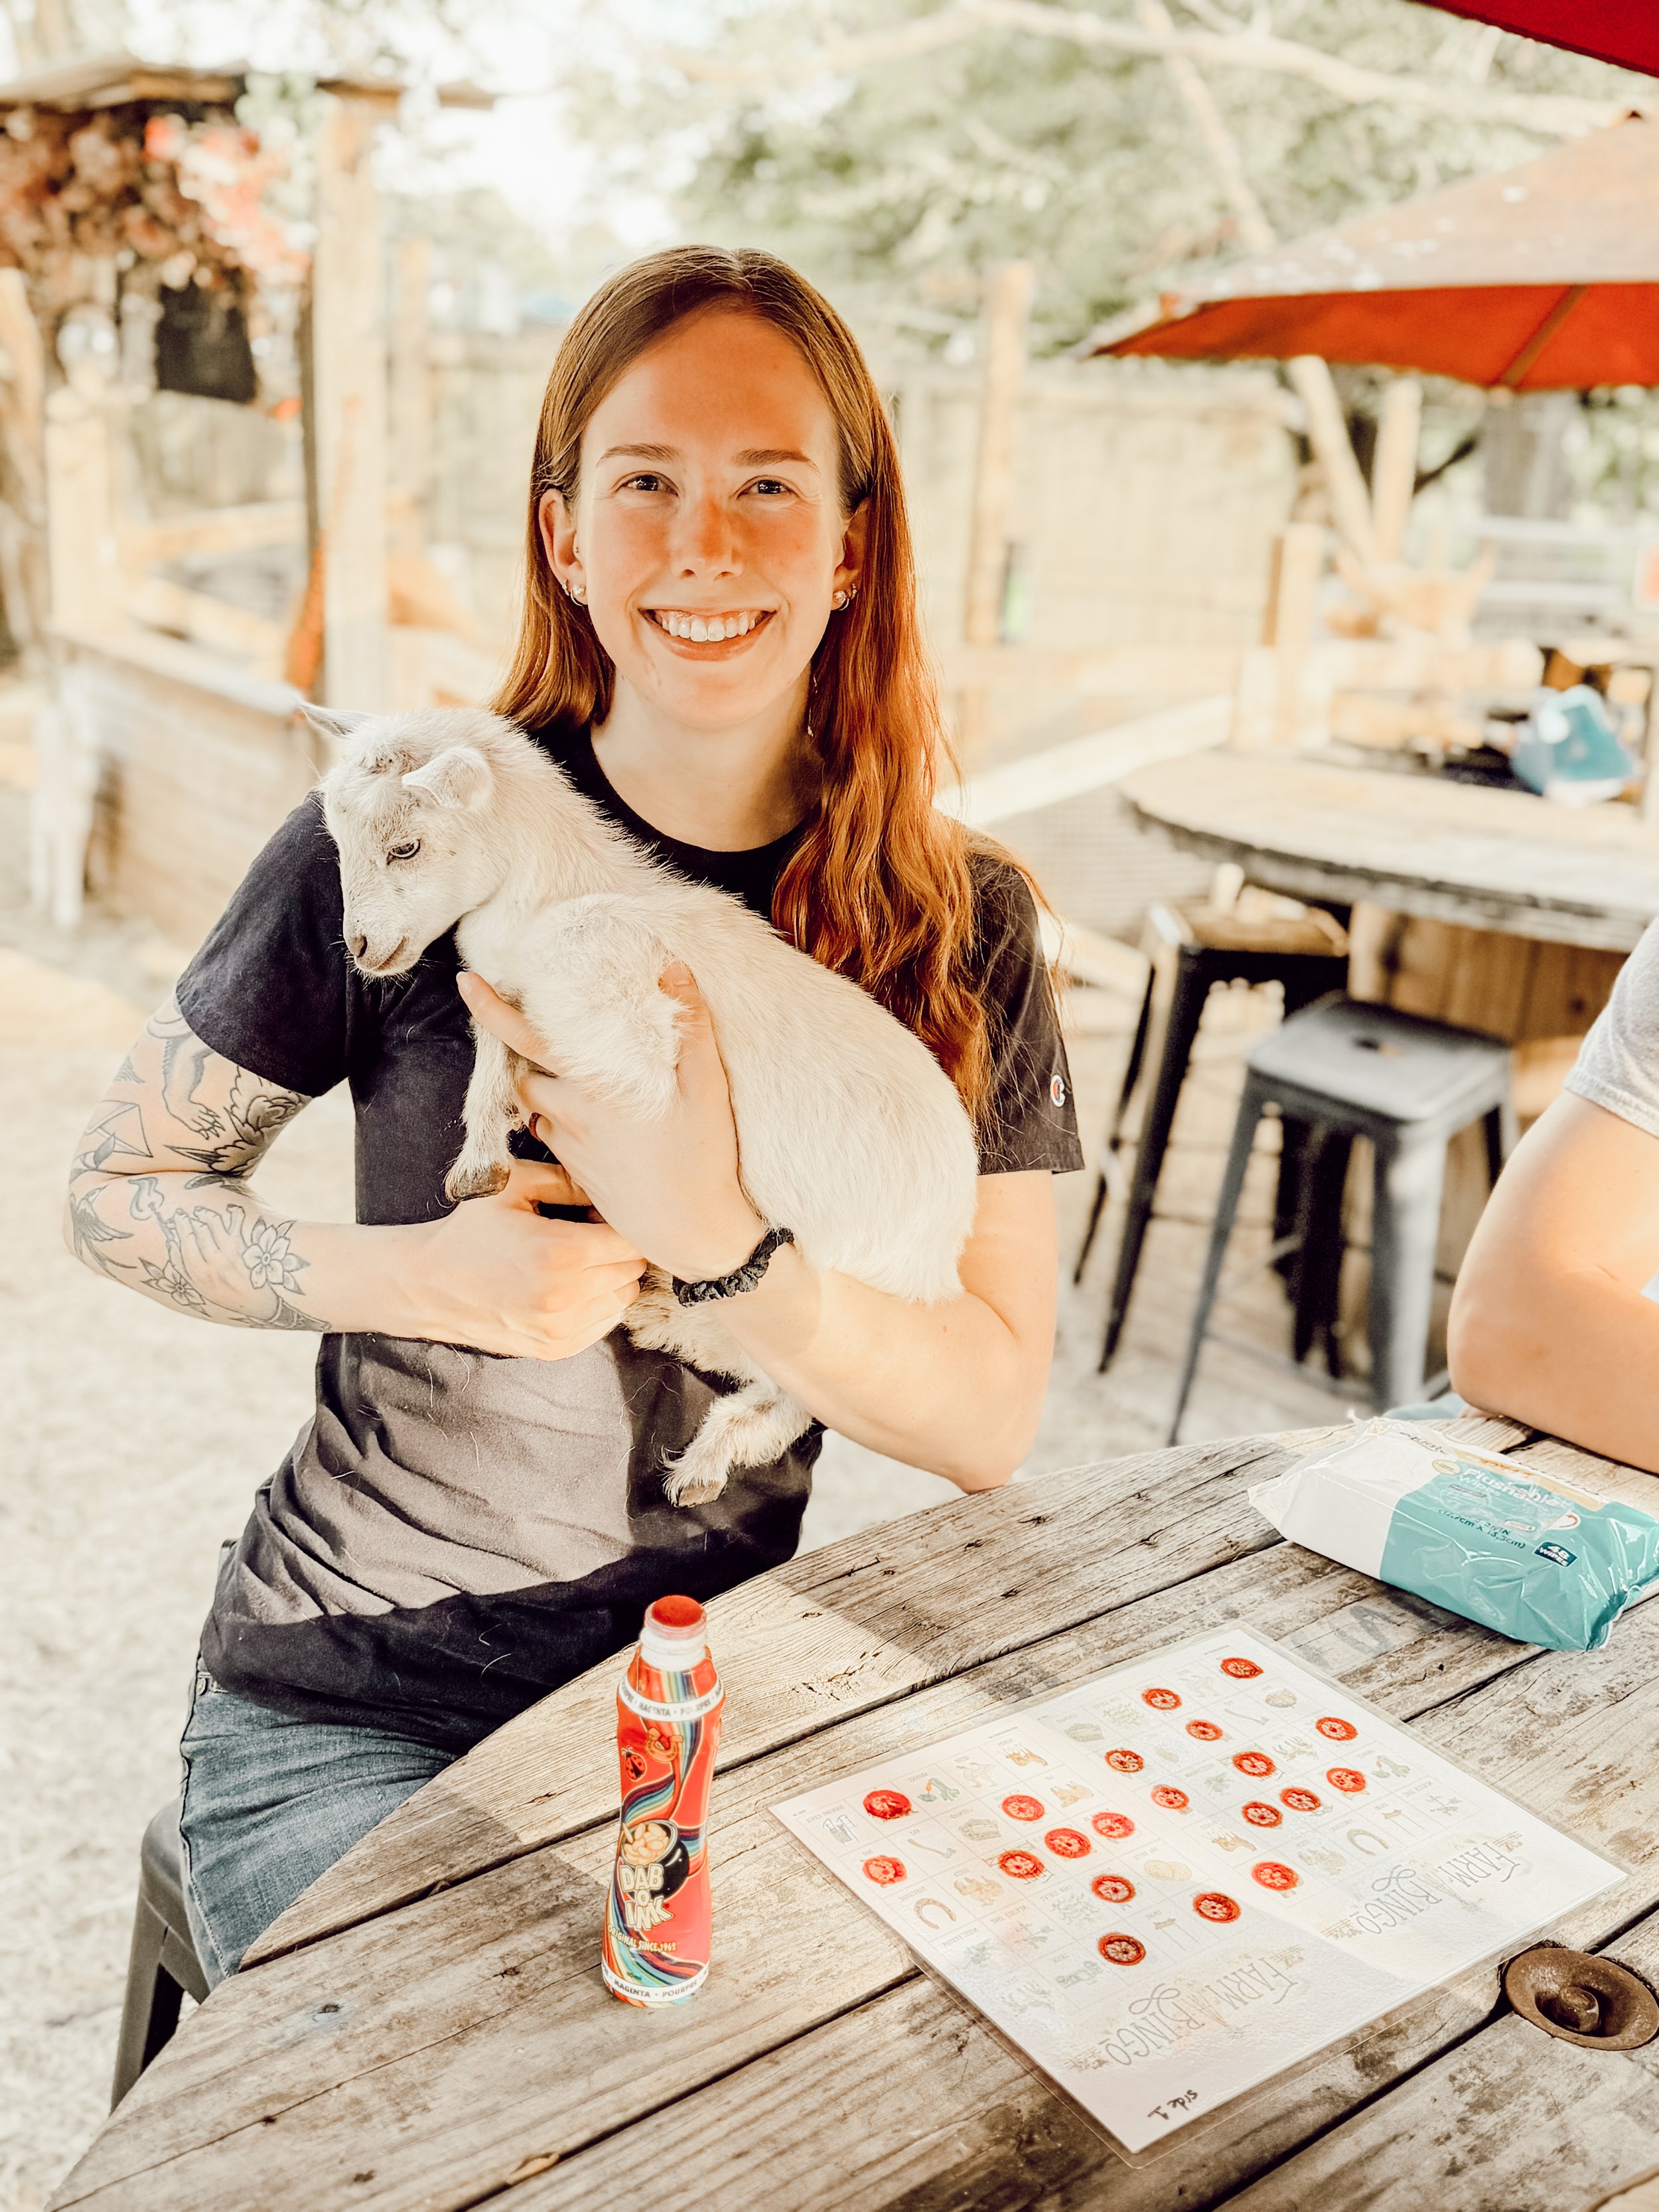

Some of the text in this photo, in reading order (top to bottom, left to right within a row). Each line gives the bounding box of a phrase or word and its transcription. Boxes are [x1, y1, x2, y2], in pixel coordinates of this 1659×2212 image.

[1540, 1547, 1569, 1566] WIPES
[1548, 1546, 1570, 1560] 48
[620, 1864, 664, 1893] DAB
[1349, 1842, 1521, 1935] FARM BINGO
[635, 1888, 651, 1907] O
[625, 1895, 675, 1932] INK
[607, 1924, 637, 1949] ORIGINAL
[638, 1940, 659, 1953] SINCE
[614, 1978, 651, 1998] MAGENTA
[1098, 1957, 1299, 2066] FARM BINGO
[1167, 2089, 1198, 2110] side
